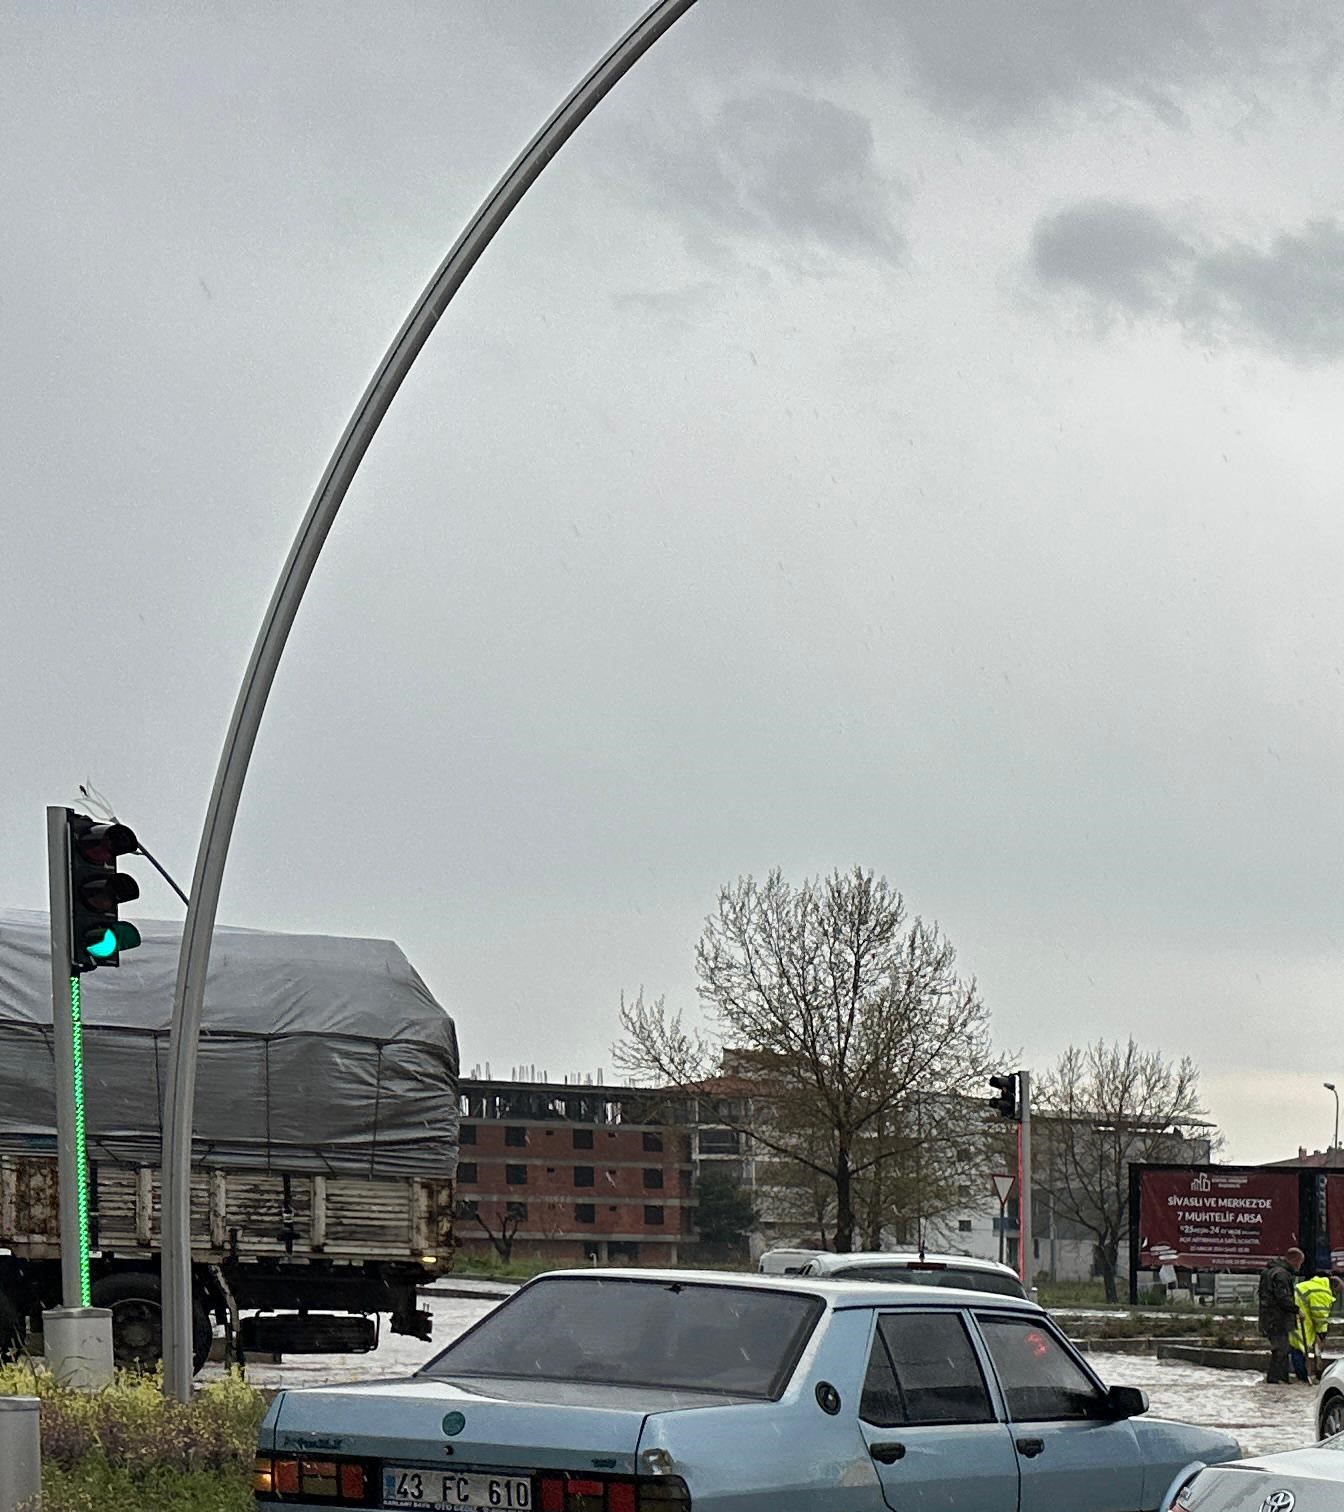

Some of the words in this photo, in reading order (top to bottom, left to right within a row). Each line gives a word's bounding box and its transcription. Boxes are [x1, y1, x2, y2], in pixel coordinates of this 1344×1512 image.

[1167, 1194, 1203, 1207] SİVASLI
[1204, 1198, 1216, 1208] VE
[1217, 1198, 1272, 1209] MERKEZ'DE
[1177, 1211, 1183, 1221] 7
[1185, 1210, 1235, 1223] MUHTELİF
[1236, 1213, 1263, 1224] ARSA
[396, 1472, 424, 1499] 43
[441, 1476, 470, 1503] FC
[488, 1480, 529, 1510] 610
